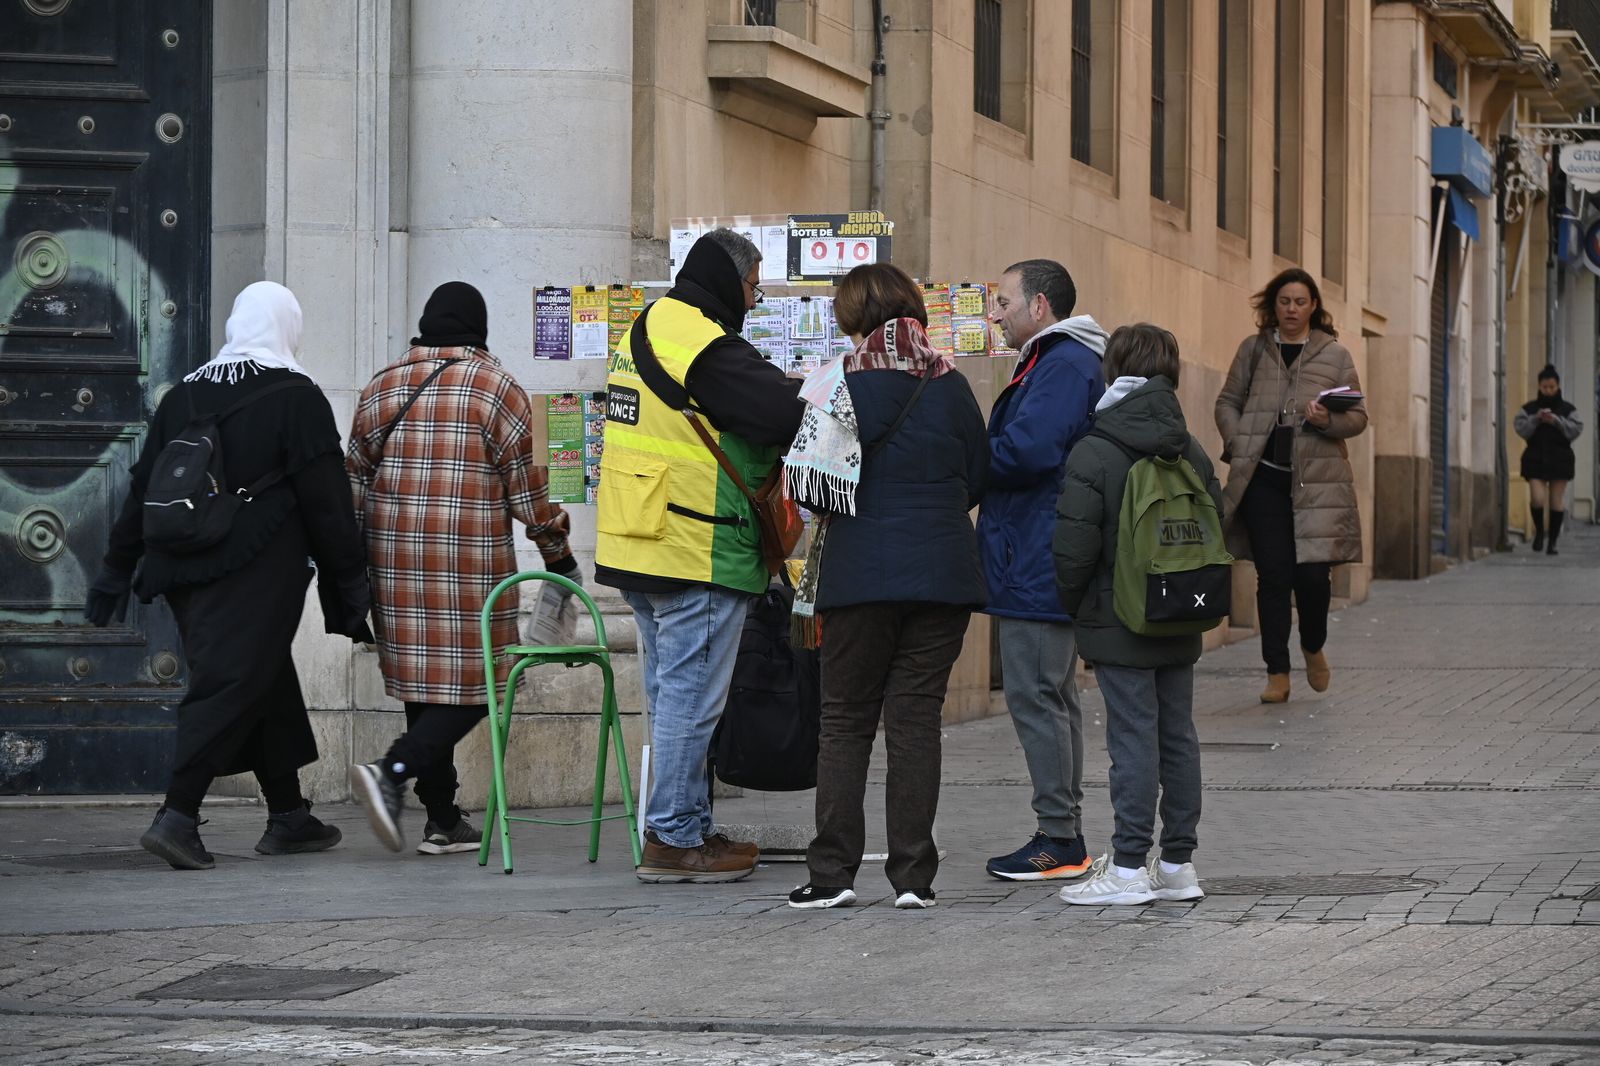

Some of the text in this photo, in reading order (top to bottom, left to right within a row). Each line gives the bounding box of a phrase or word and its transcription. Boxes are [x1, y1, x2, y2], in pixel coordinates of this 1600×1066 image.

[848, 212, 879, 223] EURO
[791, 229, 819, 237] BOTE
[838, 223, 890, 235] JACKPOT
[885, 322, 896, 346] LOLA
[609, 401, 636, 421] ONCE
